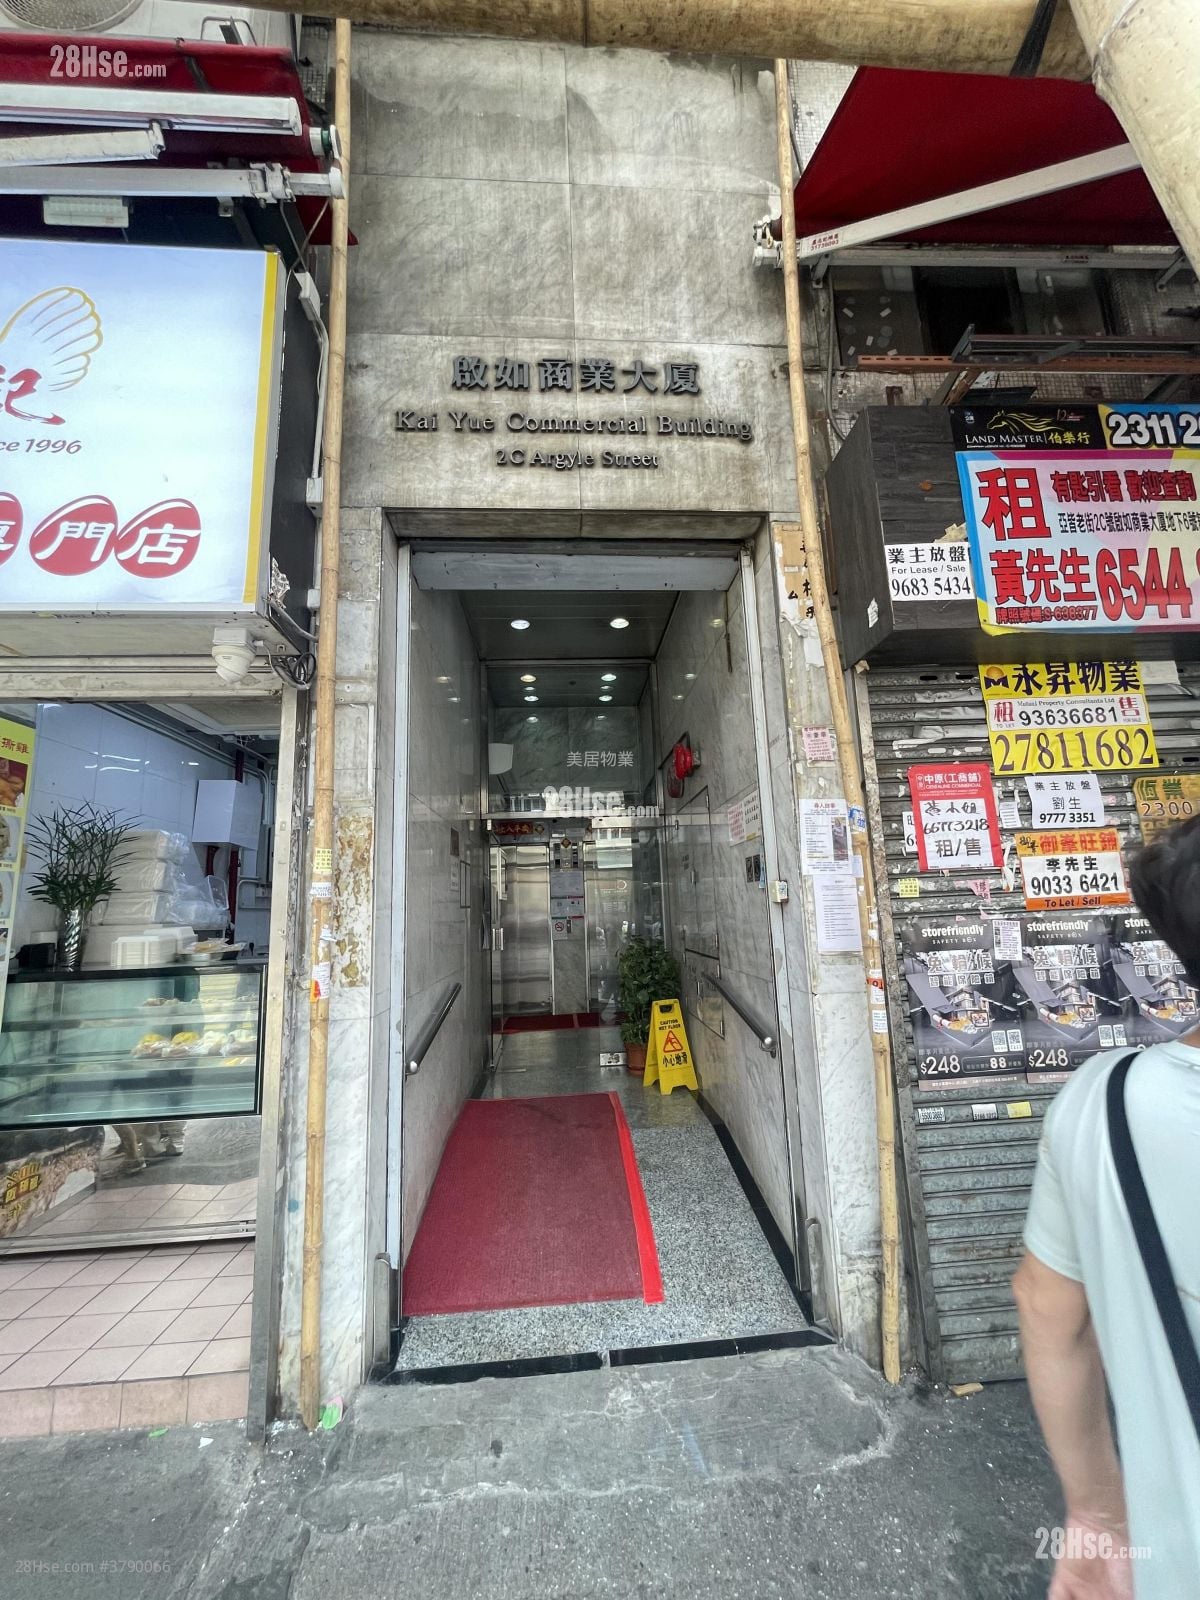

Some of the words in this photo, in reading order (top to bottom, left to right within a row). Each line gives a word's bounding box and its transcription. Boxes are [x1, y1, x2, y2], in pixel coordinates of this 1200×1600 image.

[396, 411, 438, 432] Kai
[449, 411, 495, 432] Yue
[506, 411, 648, 435] Commercial
[656, 415, 753, 443] Building
[1107, 412, 1177, 446] 2311
[1178, 412, 1200, 446] 2
[25, 438, 82, 454] 1996
[965, 435, 996, 444] LAND
[1000, 434, 1046, 443] MASTER
[529, 450, 595, 469] Argyle
[602, 450, 659, 467] Street
[976, 467, 1052, 542] 租
[891, 566, 907, 575] For
[910, 565, 938, 574] Lease
[946, 564, 966, 573] Sale
[891, 577, 929, 597] 9683
[933, 576, 971, 596] 5434
[989, 548, 1097, 605] 黃先生
[1096, 548, 1193, 621] 6544
[994, 701, 1015, 723] 租
[1118, 696, 1140, 717] 售
[1018, 706, 1118, 727] 93636681
[566, 751, 634, 768] 美居物業
[994, 728, 1153, 772] 27811682
[1035, 780, 1092, 791] 業主放盤
[1039, 813, 1066, 823] 9777
[1069, 812, 1096, 823] 3351
[1141, 801, 1193, 817] 2300
[1031, 875, 1073, 896] 9033
[1080, 872, 1119, 894] 6421
[1045, 900, 1057, 908] To
[1060, 898, 1074, 907] Let
[1082, 897, 1101, 906] Sell
[922, 924, 984, 938] storefriendly
[1027, 920, 1089, 932] storefriendly
[1124, 917, 1151, 928] store
[920, 1055, 960, 1075] $248
[990, 1057, 1007, 1069] 88
[1028, 1048, 1068, 1068] $248
